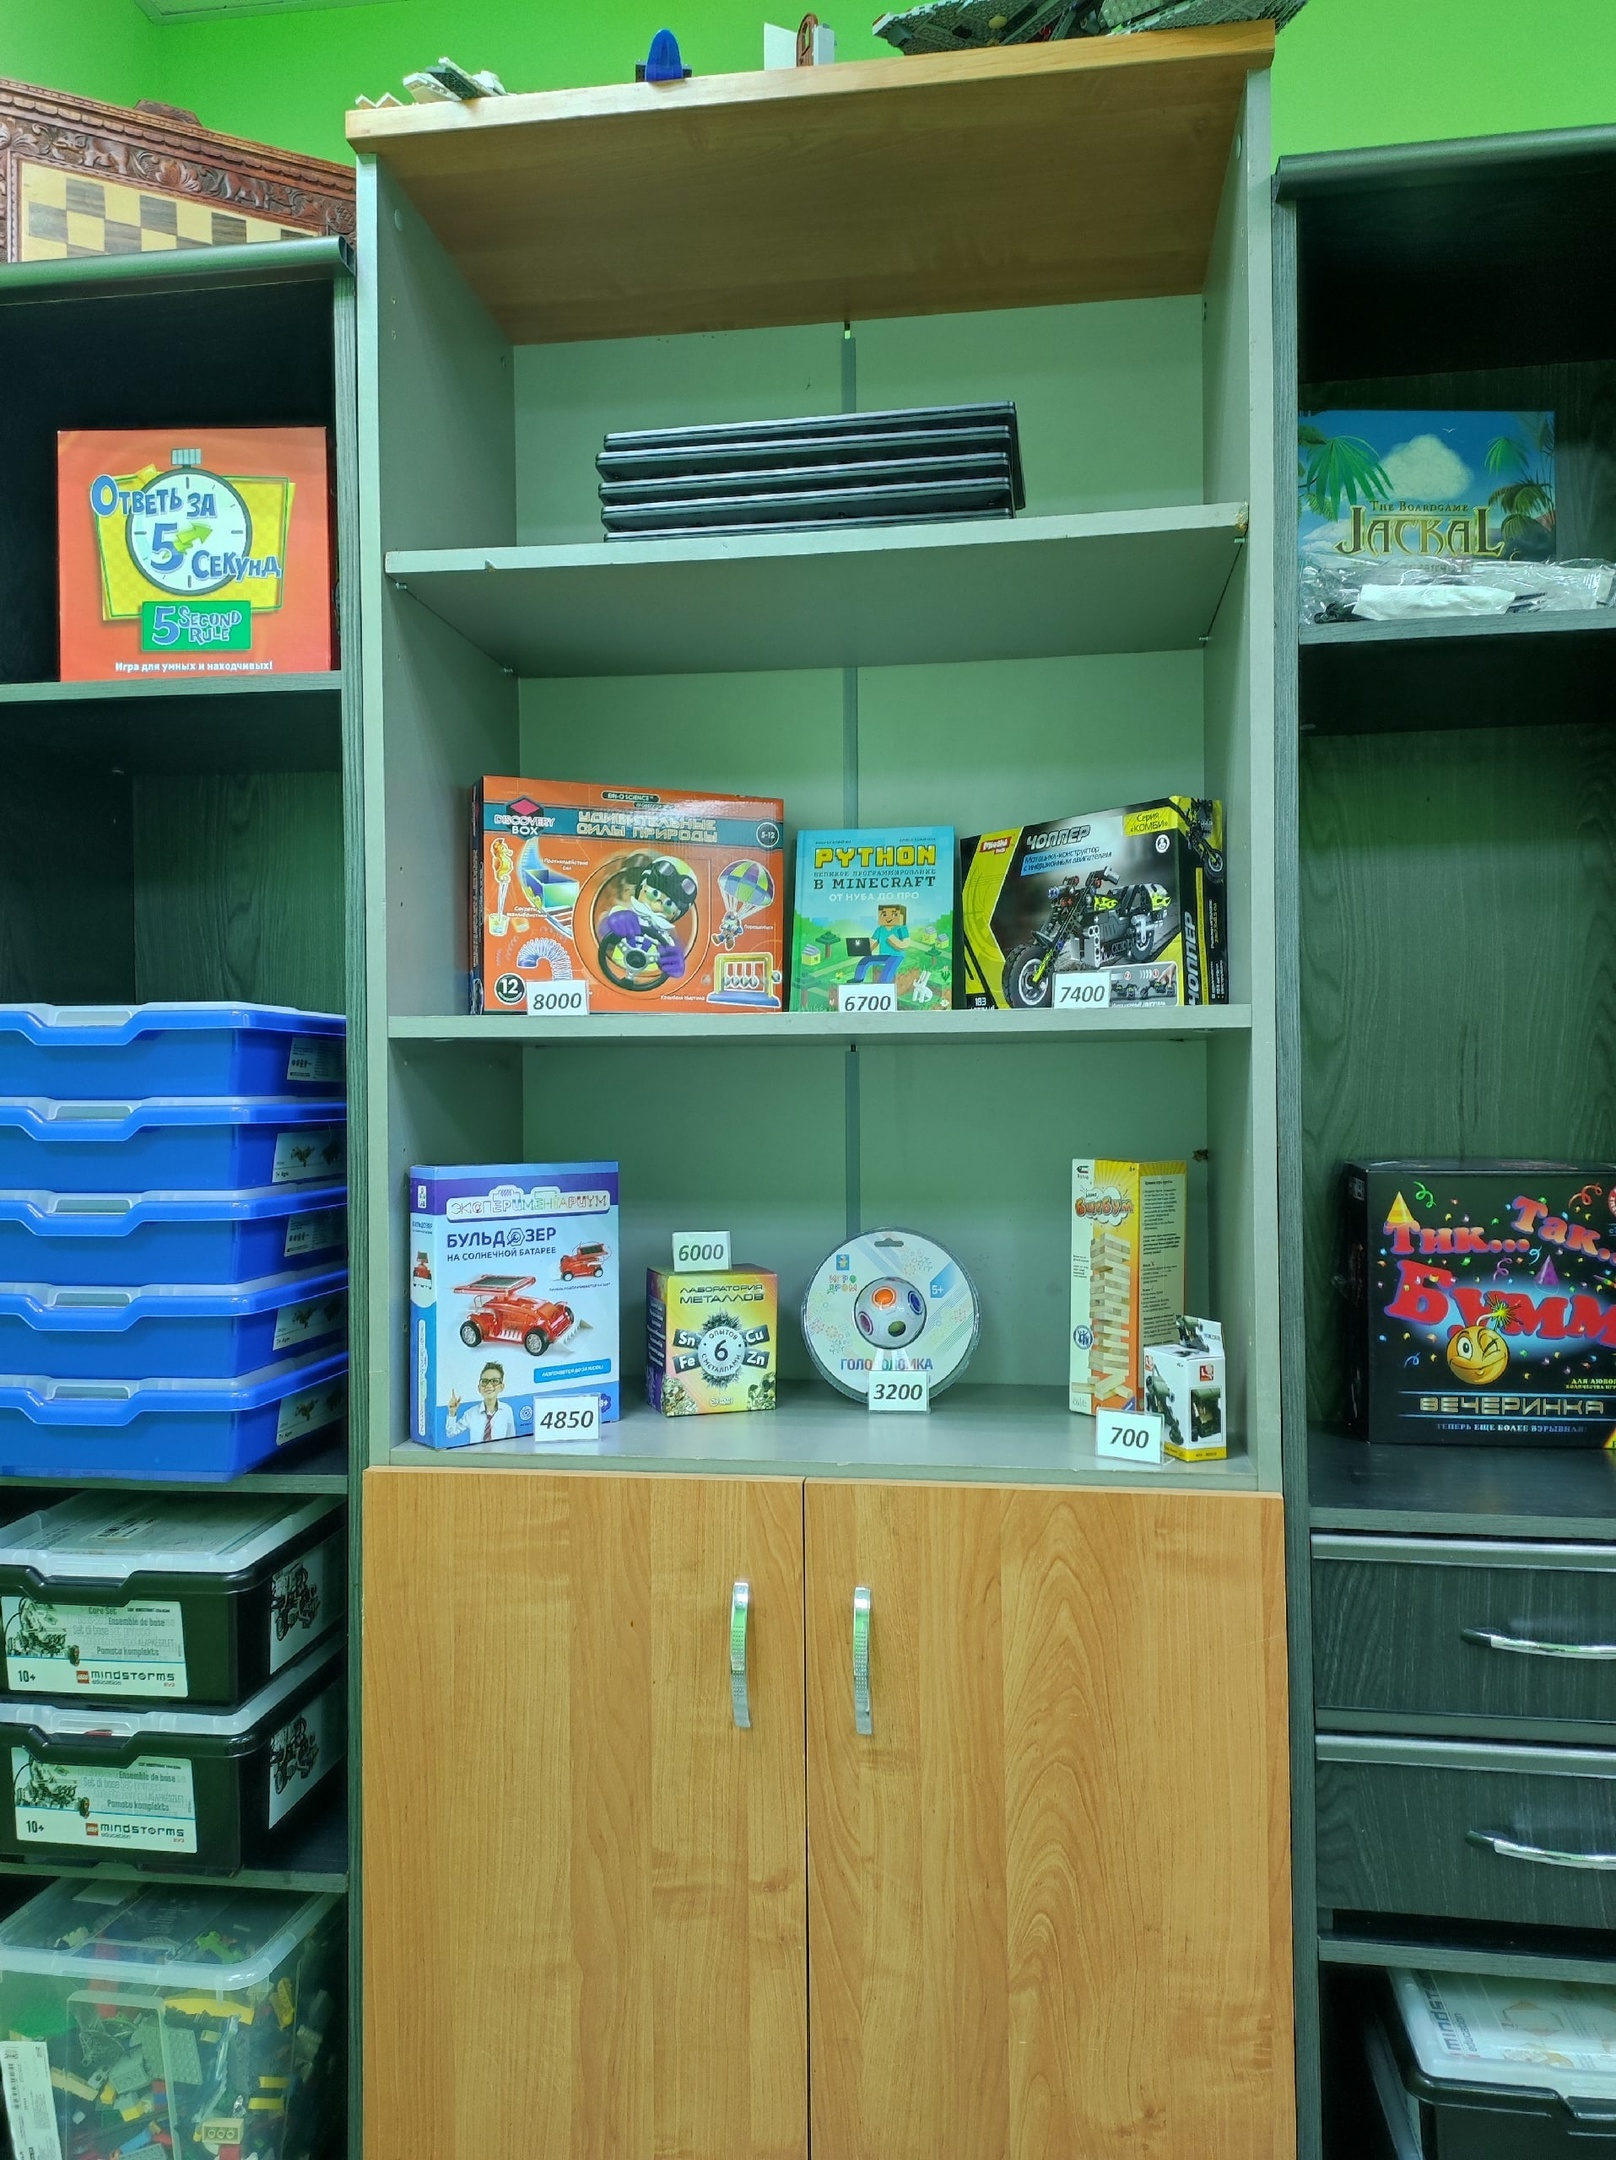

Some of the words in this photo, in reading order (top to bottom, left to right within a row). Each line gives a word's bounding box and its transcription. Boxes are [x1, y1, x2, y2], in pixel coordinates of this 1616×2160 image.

[90, 474, 183, 517] ОТВЕТЬ
[186, 492, 217, 518] ЗА
[1371, 501, 1395, 512] THE
[1399, 501, 1469, 512] BOARDGAME
[1333, 506, 1505, 557] JACKAL
[150, 523, 184, 573] 5
[191, 550, 282, 581] СЕКУНД
[152, 605, 180, 645] 5
[178, 606, 242, 628] SECOND
[189, 626, 230, 644] RULE
[115, 662, 139, 673] Игра
[141, 663, 160, 673] для
[162, 663, 196, 672] умных
[207, 661, 274, 672] находчивых!
[494, 814, 556, 828] DISCOVERY
[578, 811, 717, 831] УДИВИТЕЛЬНЫЕ
[1137, 811, 1160, 823] Серия
[512, 826, 538, 835] BOX
[577, 823, 626, 837] СИЛЫ
[633, 827, 718, 843] ПРИРОДЫ
[1026, 824, 1091, 850] ЧОППЕР
[814, 844, 936, 868] PYTHON
[1025, 847, 1100, 864] Мотоцикл-конструктор
[814, 879, 824, 890] В
[832, 876, 936, 890] MINECRAFT
[829, 893, 844, 902] ОТ
[845, 893, 874, 901] НУБА
[878, 892, 894, 901] ДО
[897, 891, 920, 900] ПРО
[500, 978, 519, 994] 12
[1060, 985, 1105, 1003] 7400
[533, 993, 582, 1010] 8000
[845, 995, 891, 1011] 6700
[974, 997, 987, 1006] 183
[447, 1254, 460, 1262] НА
[462, 1248, 517, 1260] СОЛНЕЧНОЙ
[519, 1246, 556, 1256] БАТАРЕЕ
[679, 1244, 724, 1261] 6000
[680, 1284, 762, 1293] ЛАБОРАТОРИЯ
[931, 1285, 944, 1294] 5+
[680, 1293, 764, 1304] МЕТАЛЛОВ
[678, 1333, 695, 1346] Sn
[709, 1329, 738, 1340] ОПЫТОВ
[746, 1332, 764, 1343] Cu
[714, 1339, 728, 1361] 6
[680, 1357, 696, 1369] Fe
[747, 1351, 765, 1365] Zn
[874, 1384, 922, 1400] 3200
[1419, 1397, 1604, 1415] ВЕЧЕРИНКА
[540, 1410, 594, 1429] 4850
[1436, 1423, 1471, 1431] ТЕПЕРЬ
[1474, 1424, 1495, 1432] ЕЩЕ
[1497, 1424, 1529, 1432] БОЛЕЕ
[1110, 1427, 1149, 1448] 700
[88, 1607, 104, 1615] Core
[105, 1607, 117, 1615] Set
[108, 1617, 139, 1626] Ensemble
[140, 1618, 149, 1627] de
[150, 1618, 165, 1627] base
[18, 1670, 36, 1682] 10+
[119, 1770, 149, 1780] Ensemble
[151, 1773, 159, 1781] de
[160, 1773, 175, 1783] base
[26, 1820, 45, 1834] 10+
